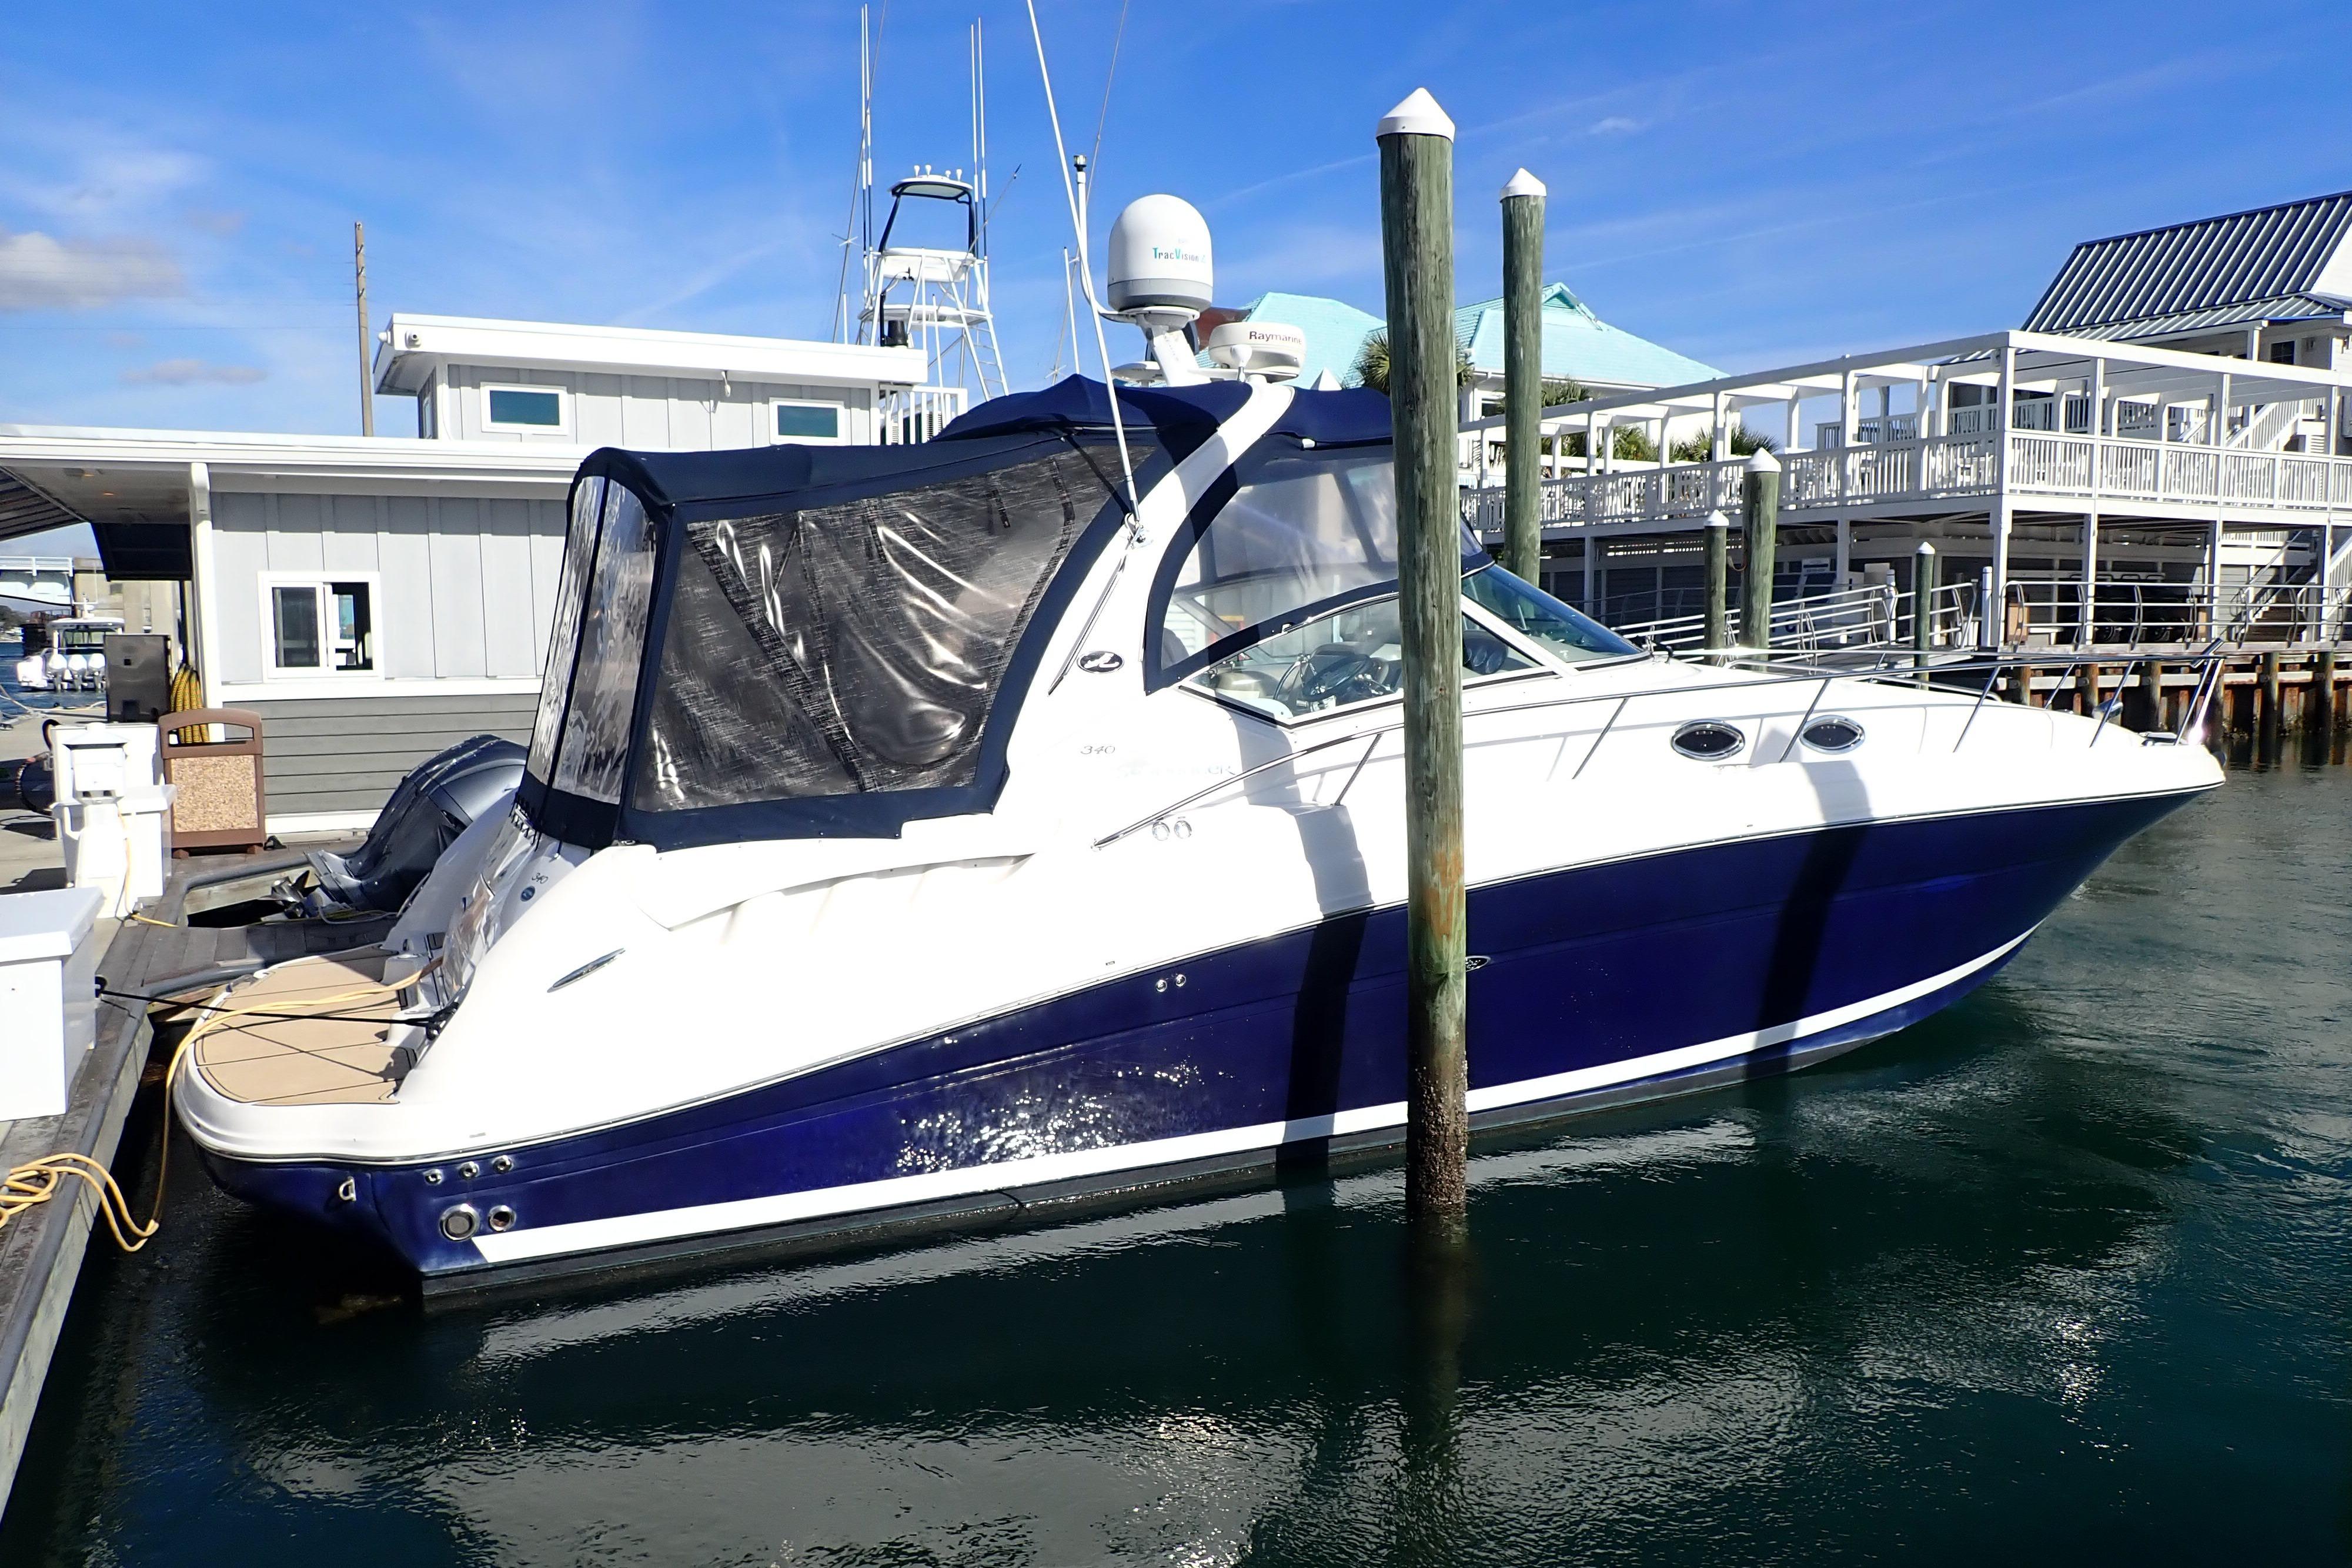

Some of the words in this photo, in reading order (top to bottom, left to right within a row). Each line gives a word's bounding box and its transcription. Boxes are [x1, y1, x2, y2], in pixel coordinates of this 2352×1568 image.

[1152, 247, 1199, 262] TracVision
[1249, 330, 1302, 345] Raymarine
[1080, 745, 1115, 755] 340
